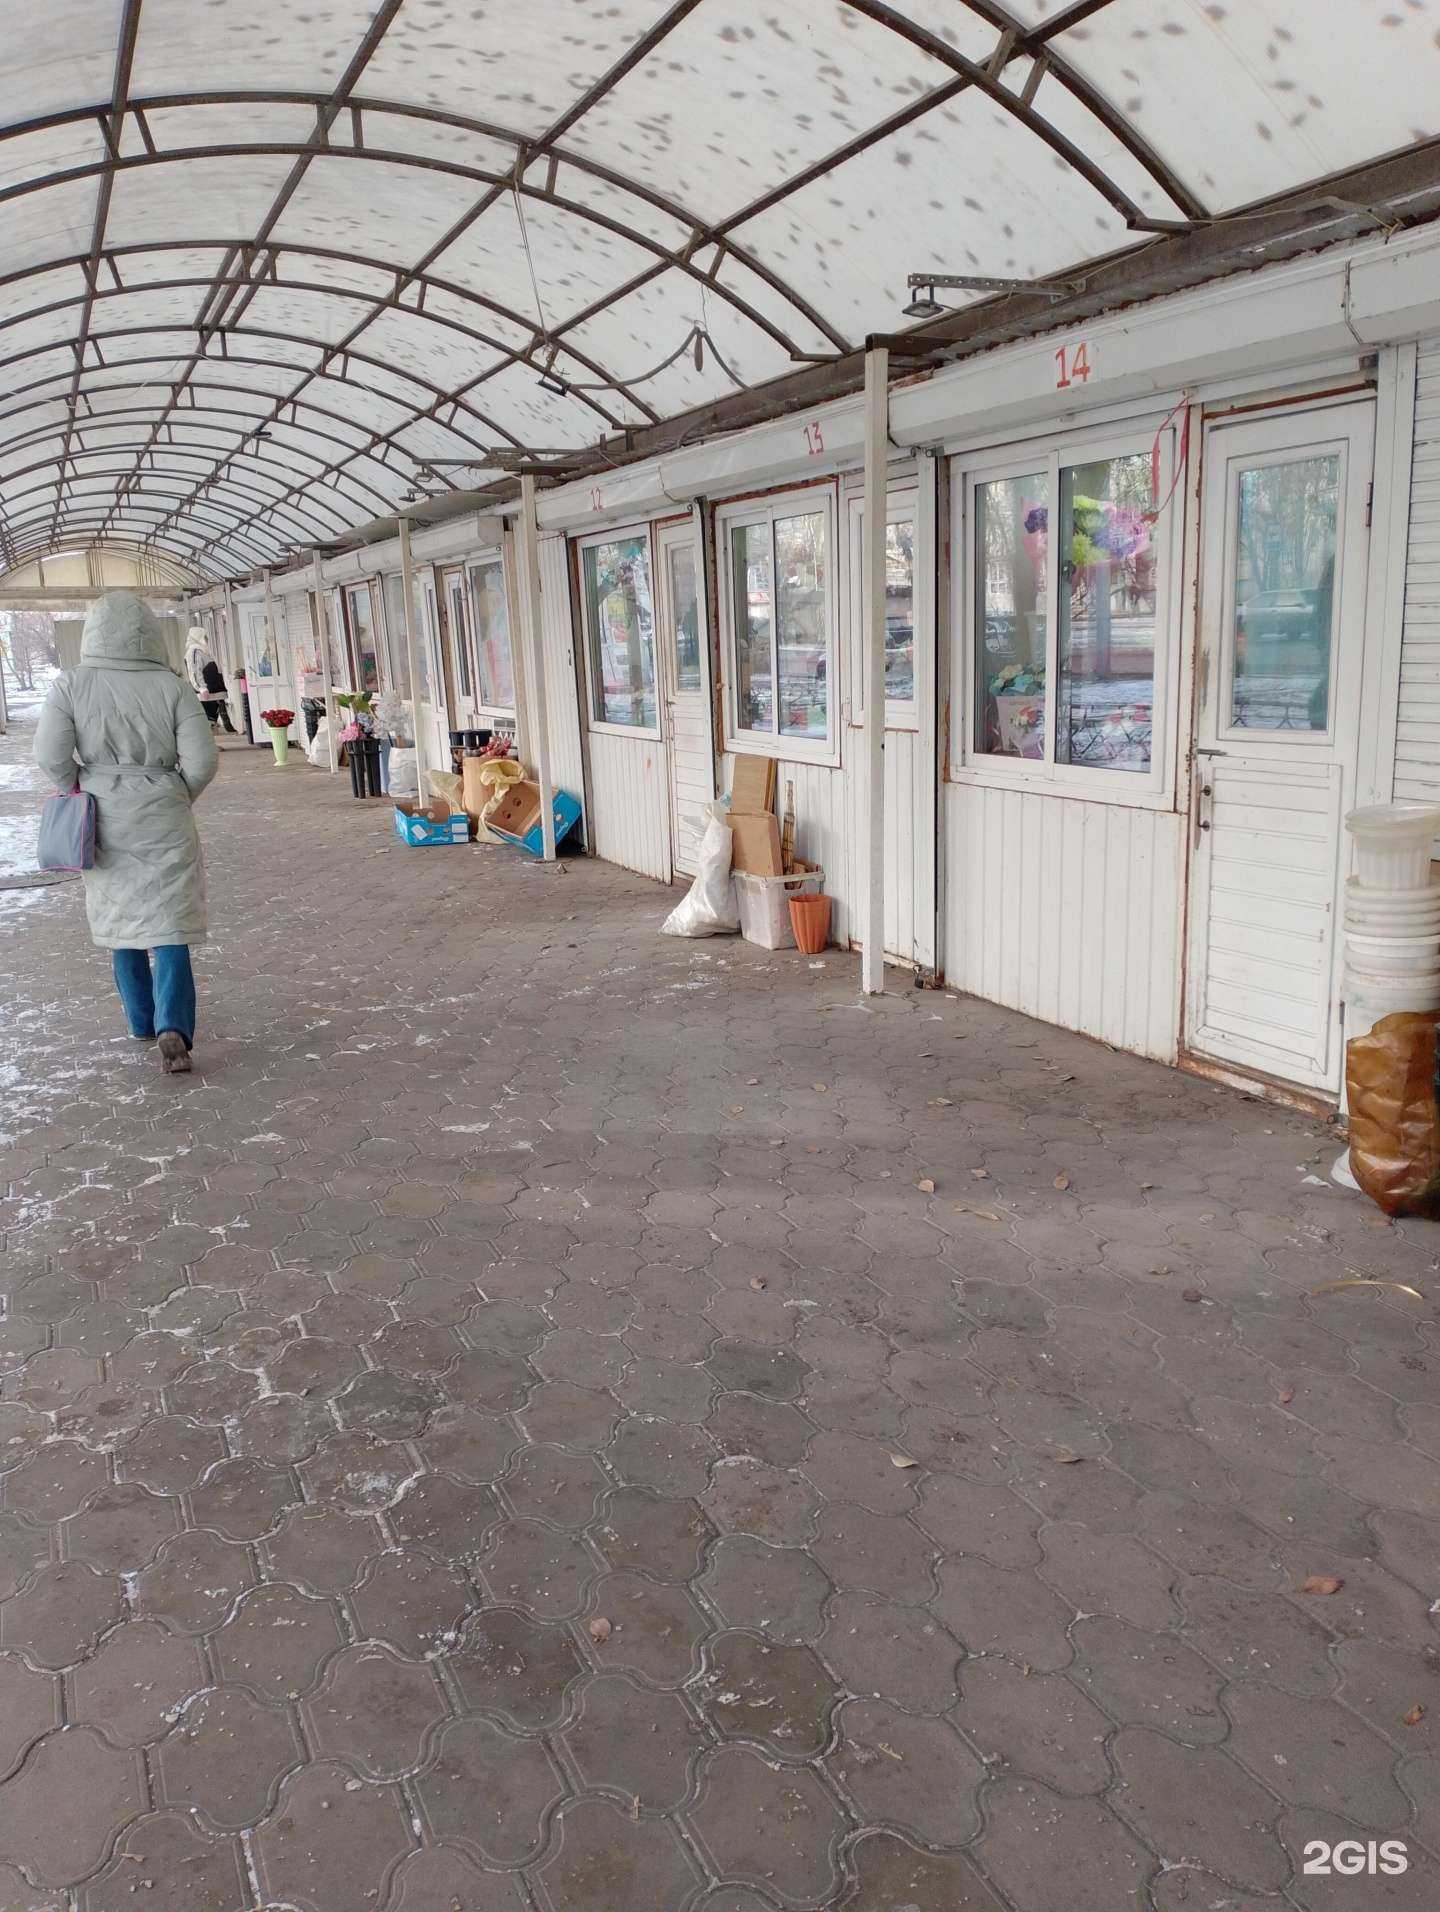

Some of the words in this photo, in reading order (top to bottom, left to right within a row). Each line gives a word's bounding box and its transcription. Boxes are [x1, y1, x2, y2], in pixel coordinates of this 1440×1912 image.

[1056, 342, 1090, 388] 14
[803, 421, 824, 455] 13
[591, 487, 604, 512] 12
